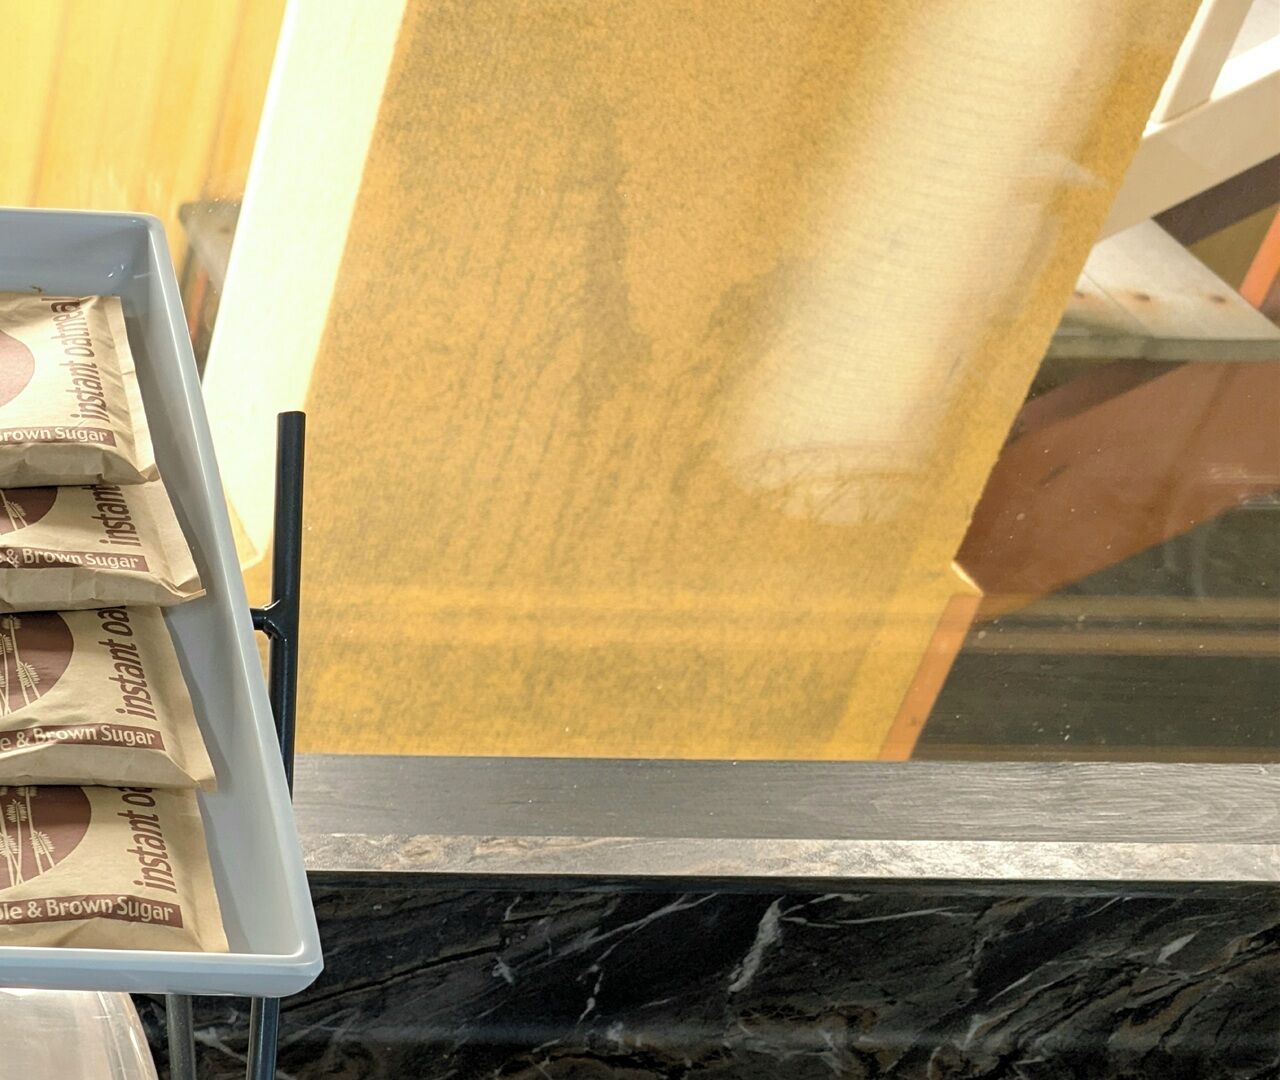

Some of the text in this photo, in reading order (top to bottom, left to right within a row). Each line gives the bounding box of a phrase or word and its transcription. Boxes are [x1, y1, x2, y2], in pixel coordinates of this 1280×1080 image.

[60, 363, 110, 423] instant
[55, 428, 107, 443] Sugar
[82, 485, 140, 546] instant
[6, 550, 19, 567] &
[24, 549, 81, 564] Brown
[86, 554, 138, 571] Sugar
[99, 639, 156, 720] instant
[17, 732, 30, 747] &
[33, 726, 97, 744] Brown
[101, 726, 155, 745] Sugar
[118, 811, 176, 893] instant
[28, 902, 41, 917] &
[46, 897, 112, 915] Brown
[117, 897, 173, 921] Sugar
